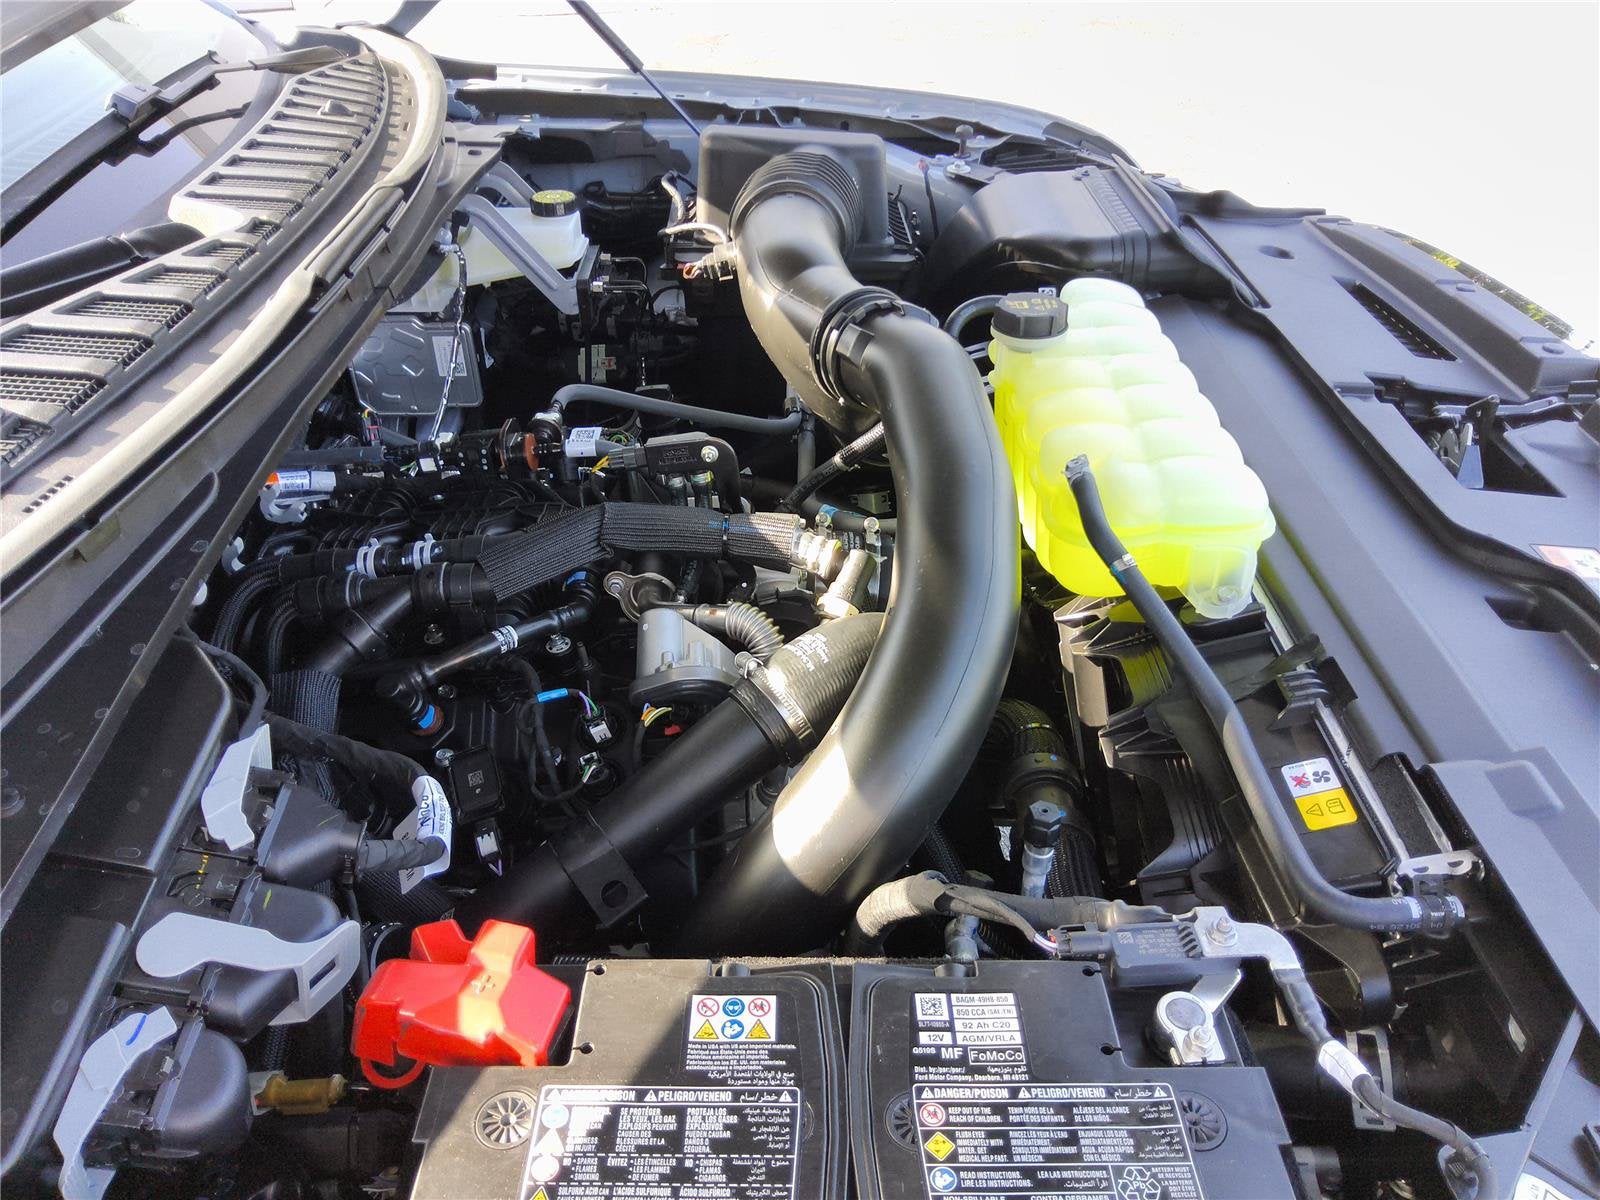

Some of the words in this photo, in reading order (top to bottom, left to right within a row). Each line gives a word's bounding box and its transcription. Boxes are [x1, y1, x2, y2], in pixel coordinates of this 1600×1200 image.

[956, 1008, 970, 1016] 850
[971, 1008, 986, 1016] CCA
[928, 1034, 944, 1042] 12V
[962, 1034, 1016, 1042] AGM/VRLA
[941, 1048, 963, 1058] MF
[970, 1050, 1022, 1060] FoMoCo
[658, 1091, 732, 1102] PELIGRO/VENENO
[934, 1088, 1009, 1098] DANGER/POISON
[1031, 1088, 1106, 1098] PELIGRO/VENENO
[630, 1106, 661, 1115] PROTÉGER
[686, 1115, 703, 1123] OJOS,
[705, 1115, 717, 1123] LOS
[718, 1115, 738, 1123] GASES
[607, 1156, 627, 1166] ÉVITEZ
[646, 1156, 676, 1165] ÉTINCELLES
[685, 1159, 694, 1167] NO
[960, 1171, 975, 1179] READ
[977, 1171, 1022, 1179] INSTRUCTIONS.
[1037, 1170, 1049, 1178] LEA
[1050, 1170, 1060, 1178] LAS
[1062, 1170, 1110, 1178] INSTRUCCIONES.
[1133, 1180, 1146, 1189] Pb
[558, 1187, 584, 1196] SULFURIC
[585, 1187, 598, 1196] ACID
[600, 1187, 610, 1196] CAN
[612, 1187, 635, 1196] L'ACIDE
[636, 1187, 672, 1196] SULFURIQUE
[680, 1186, 698, 1197] ÁCIDO
[698, 1186, 730, 1197] SULFÚRICO
